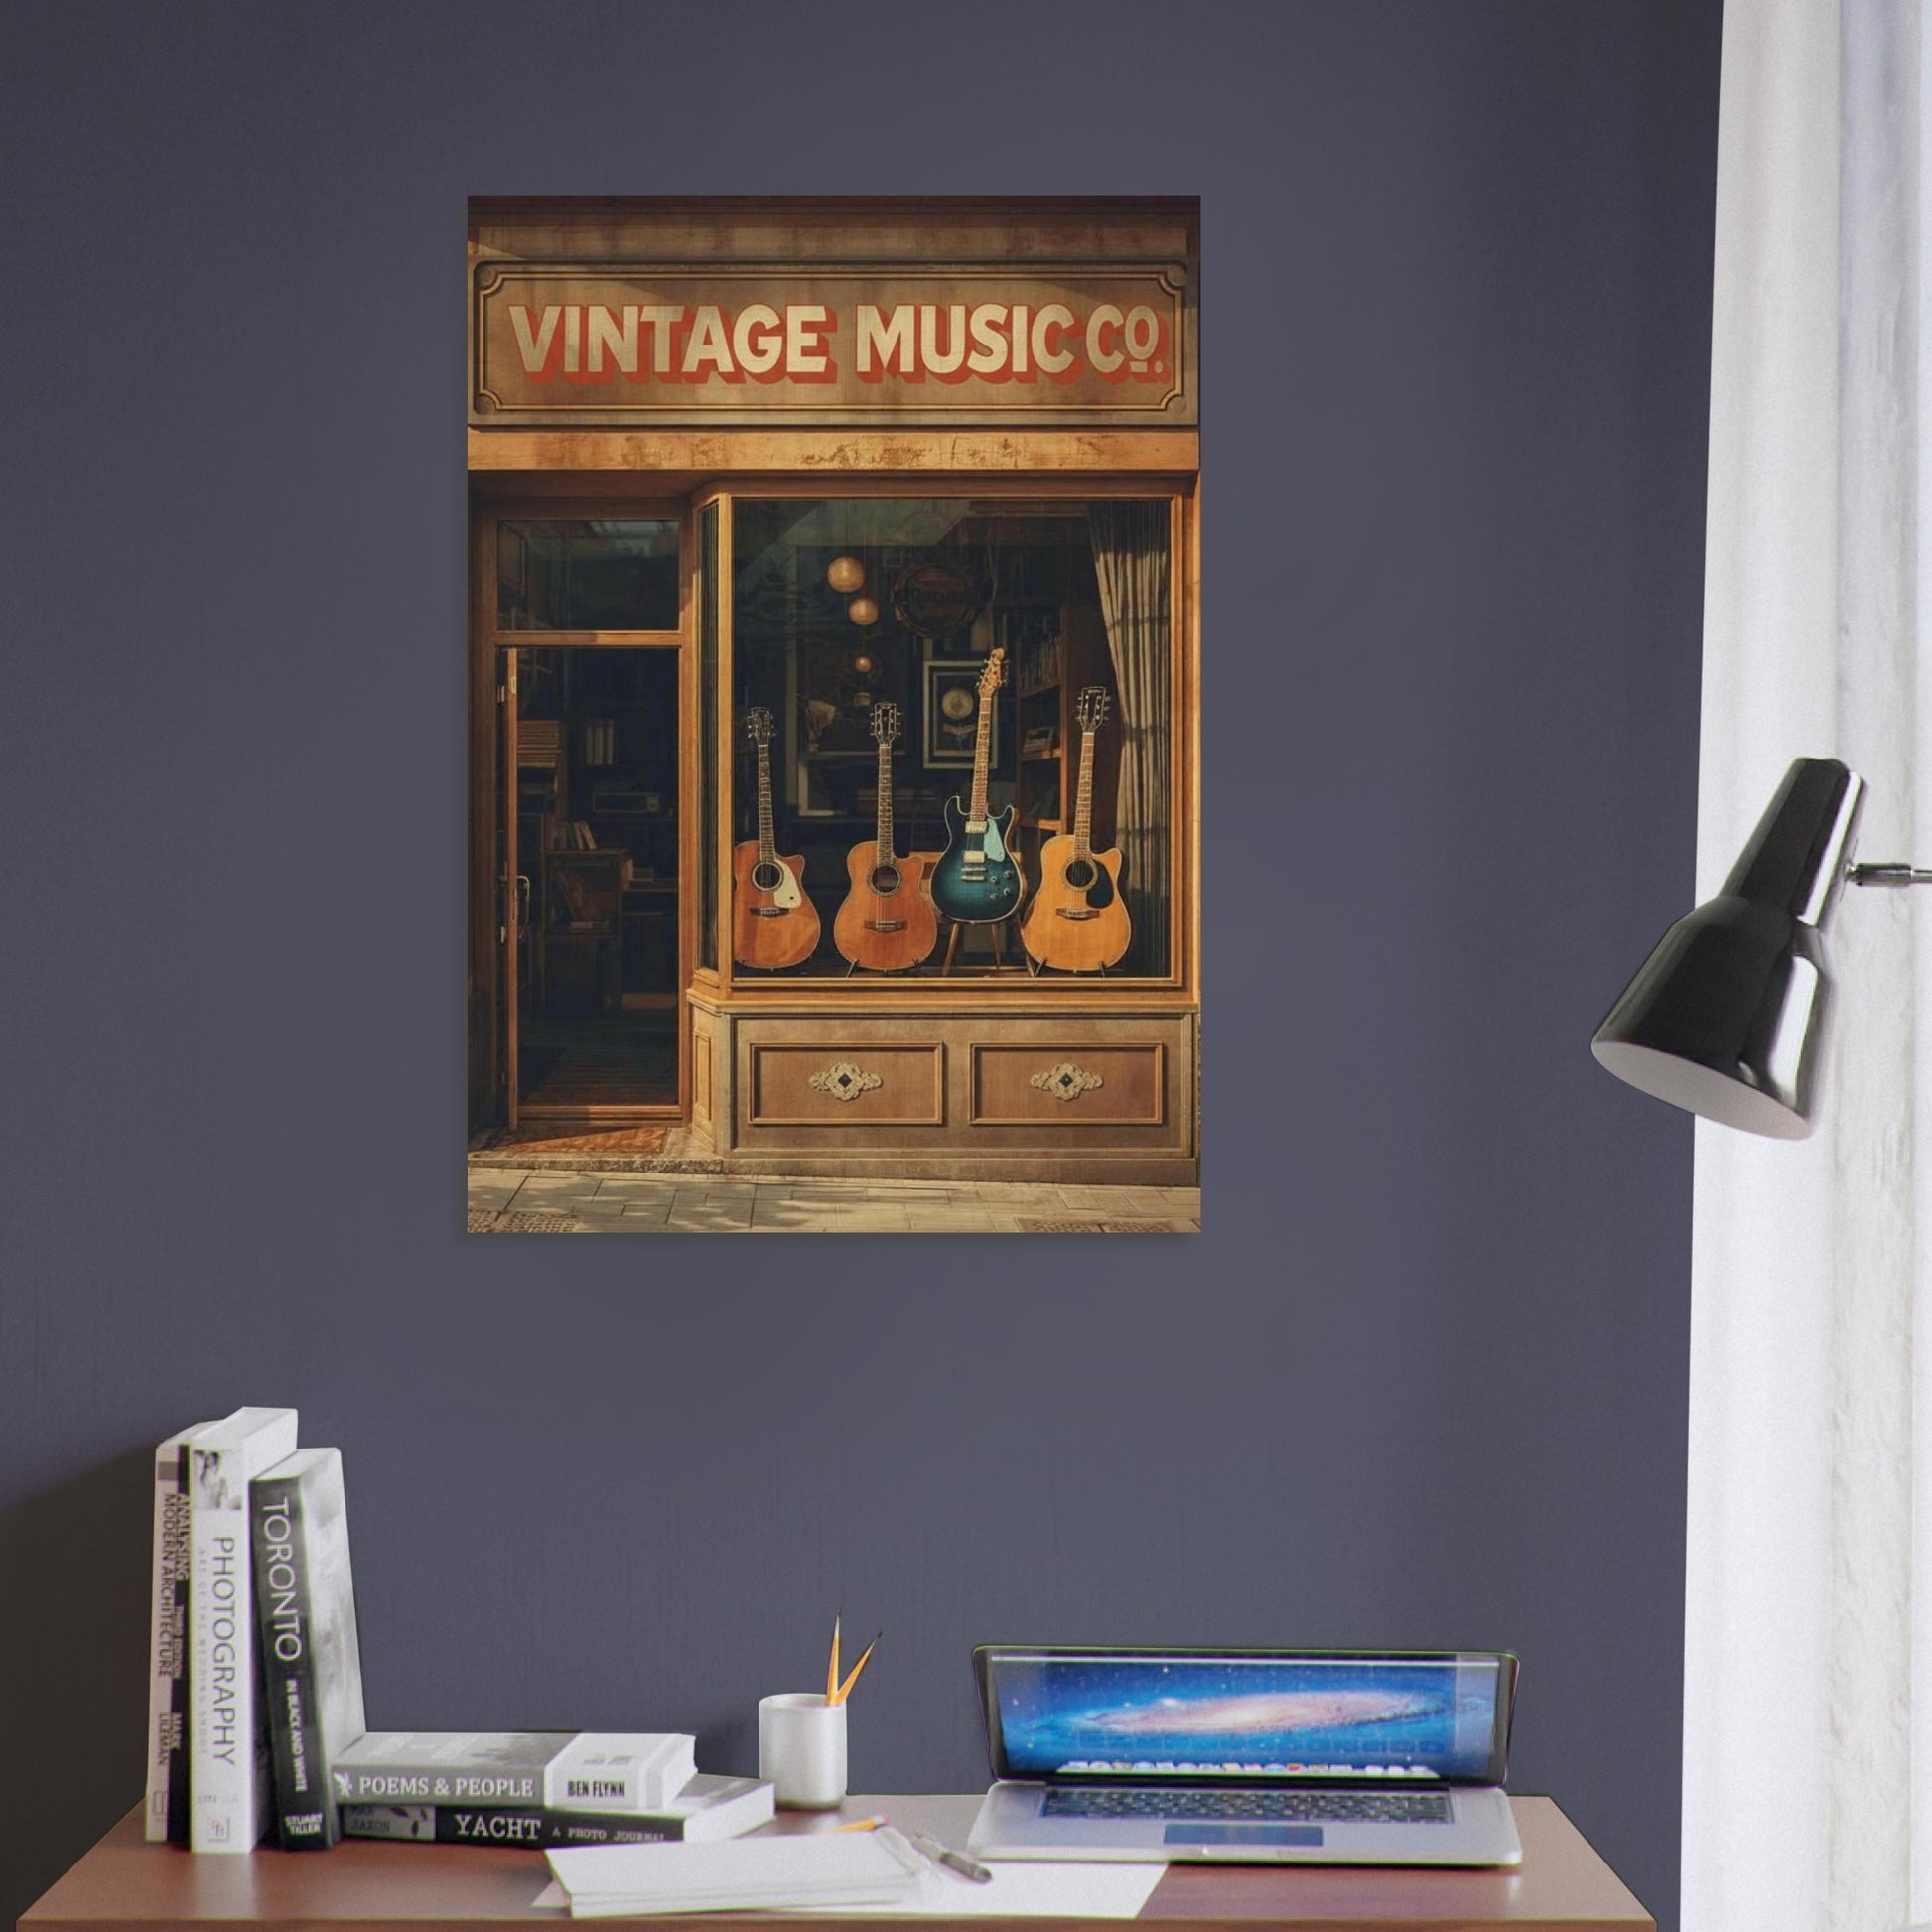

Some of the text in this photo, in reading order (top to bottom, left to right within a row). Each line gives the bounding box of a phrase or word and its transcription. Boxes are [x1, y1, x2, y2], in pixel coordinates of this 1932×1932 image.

[508, 302, 837, 384] VINTAGE
[857, 302, 1077, 384] MUSIC
[176, 1493, 191, 1580] ANALYSING
[262, 1496, 303, 1660] TORONTO
[159, 1493, 176, 1678] MODERN ARCHITECTURE
[211, 1536, 236, 1765] PHOTOGRAPHY
[286, 1679, 308, 1792] IN BLACK AND WHITE
[359, 1777, 534, 1797] POEMS & PEOPLE
[455, 1814, 541, 1839] YACHT
[567, 1780, 625, 1797] BEN FLYNN
[552, 1826, 561, 1837] A
[568, 1827, 607, 1840] PHOTO
